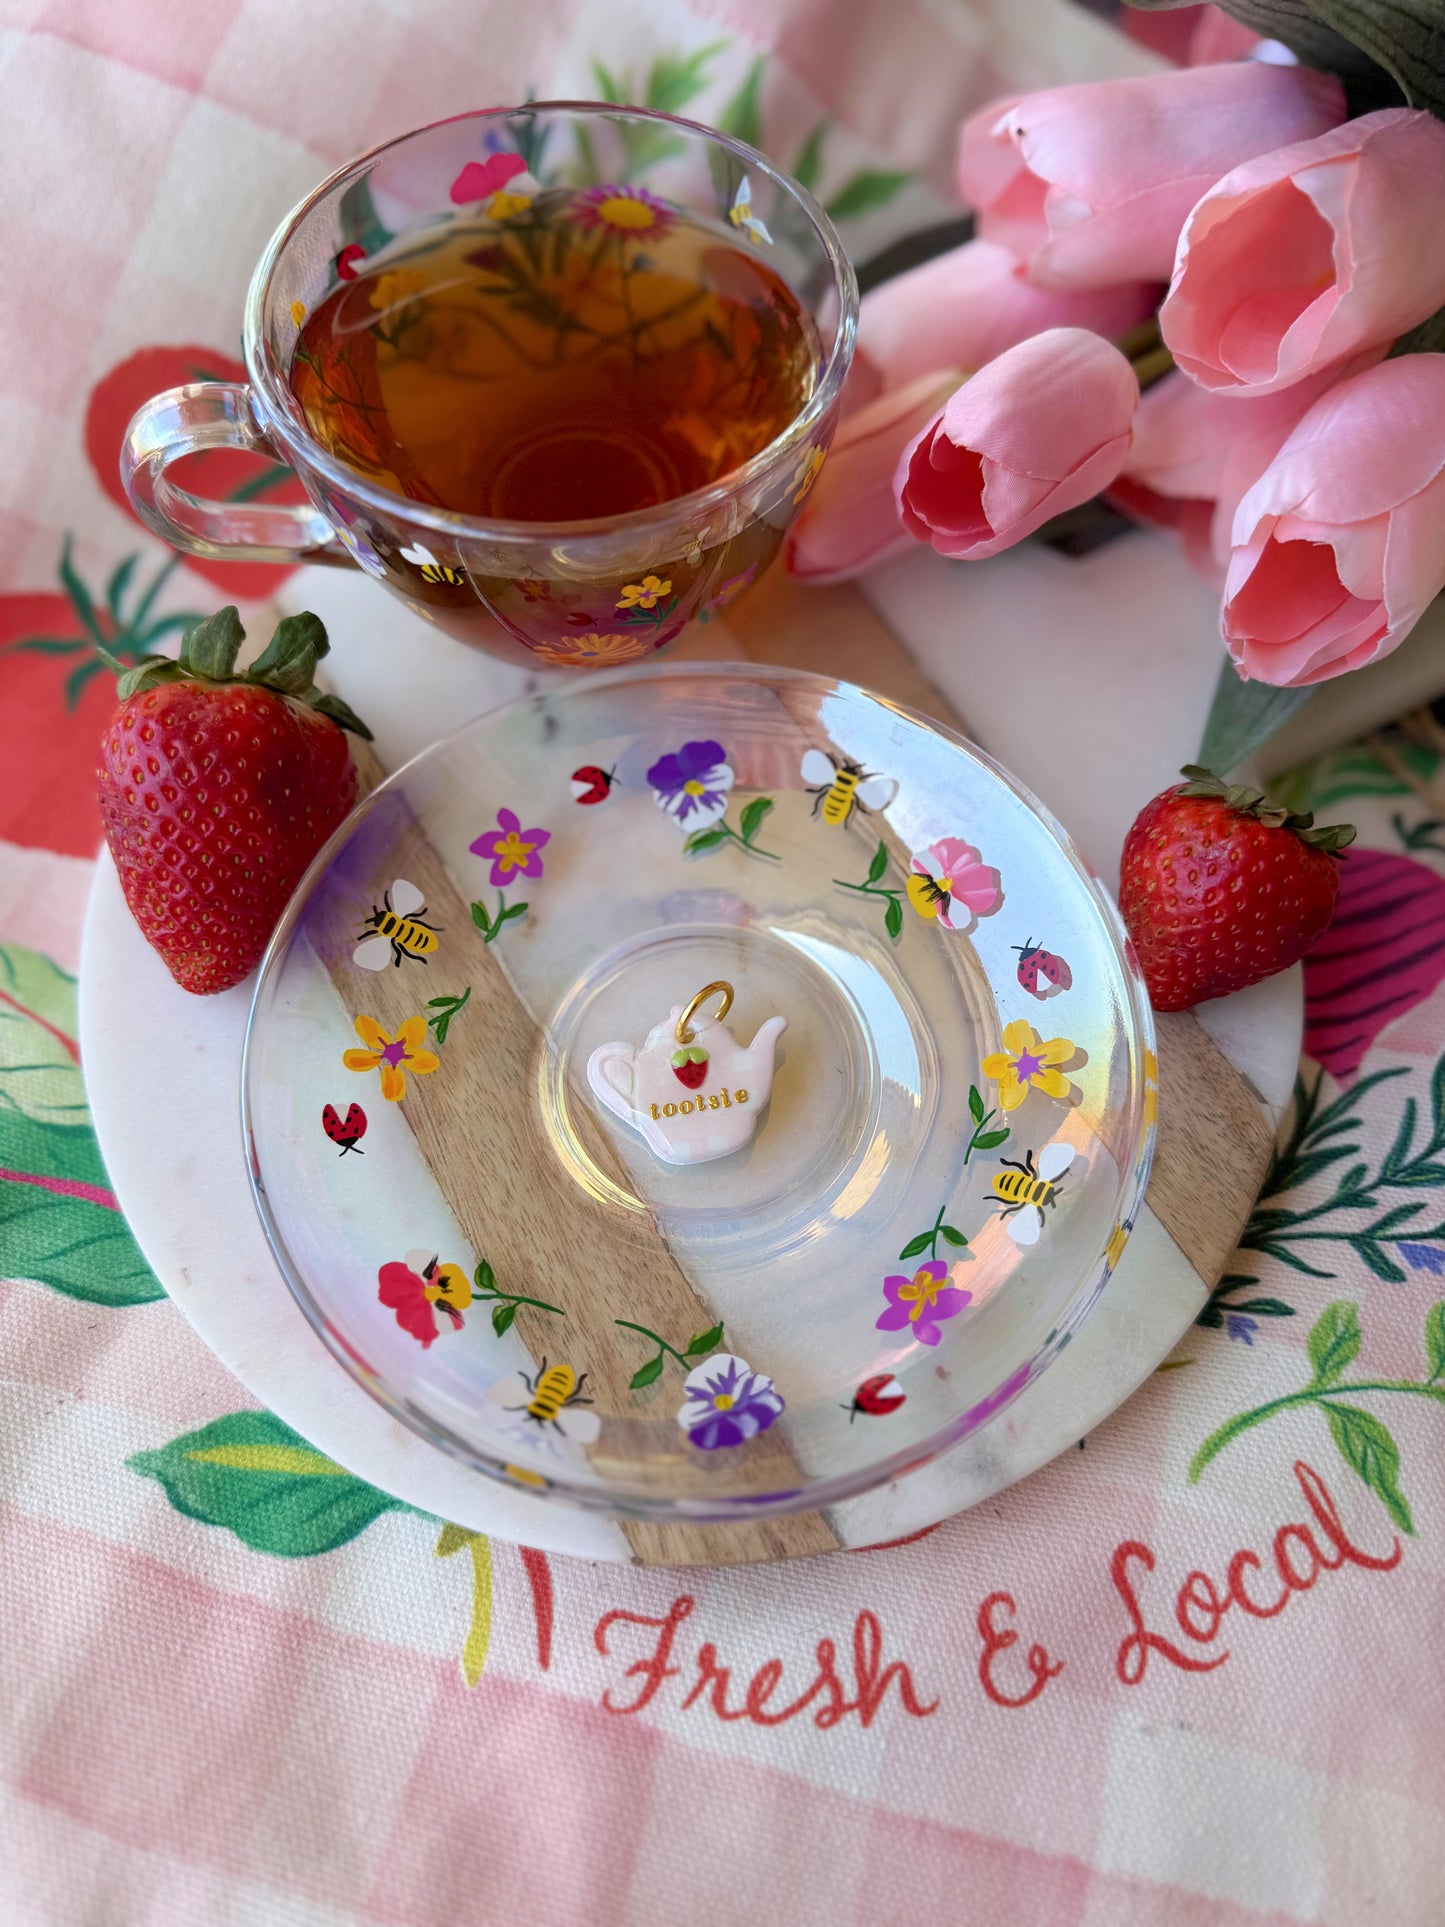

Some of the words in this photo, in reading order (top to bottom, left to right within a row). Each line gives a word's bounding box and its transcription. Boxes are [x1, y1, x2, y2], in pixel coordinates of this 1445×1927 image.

[649, 1087, 749, 1120] tootsie
[594, 1595, 940, 1730] Fresh
[977, 1591, 1063, 1708] &
[1111, 1459, 1402, 1686] Local
